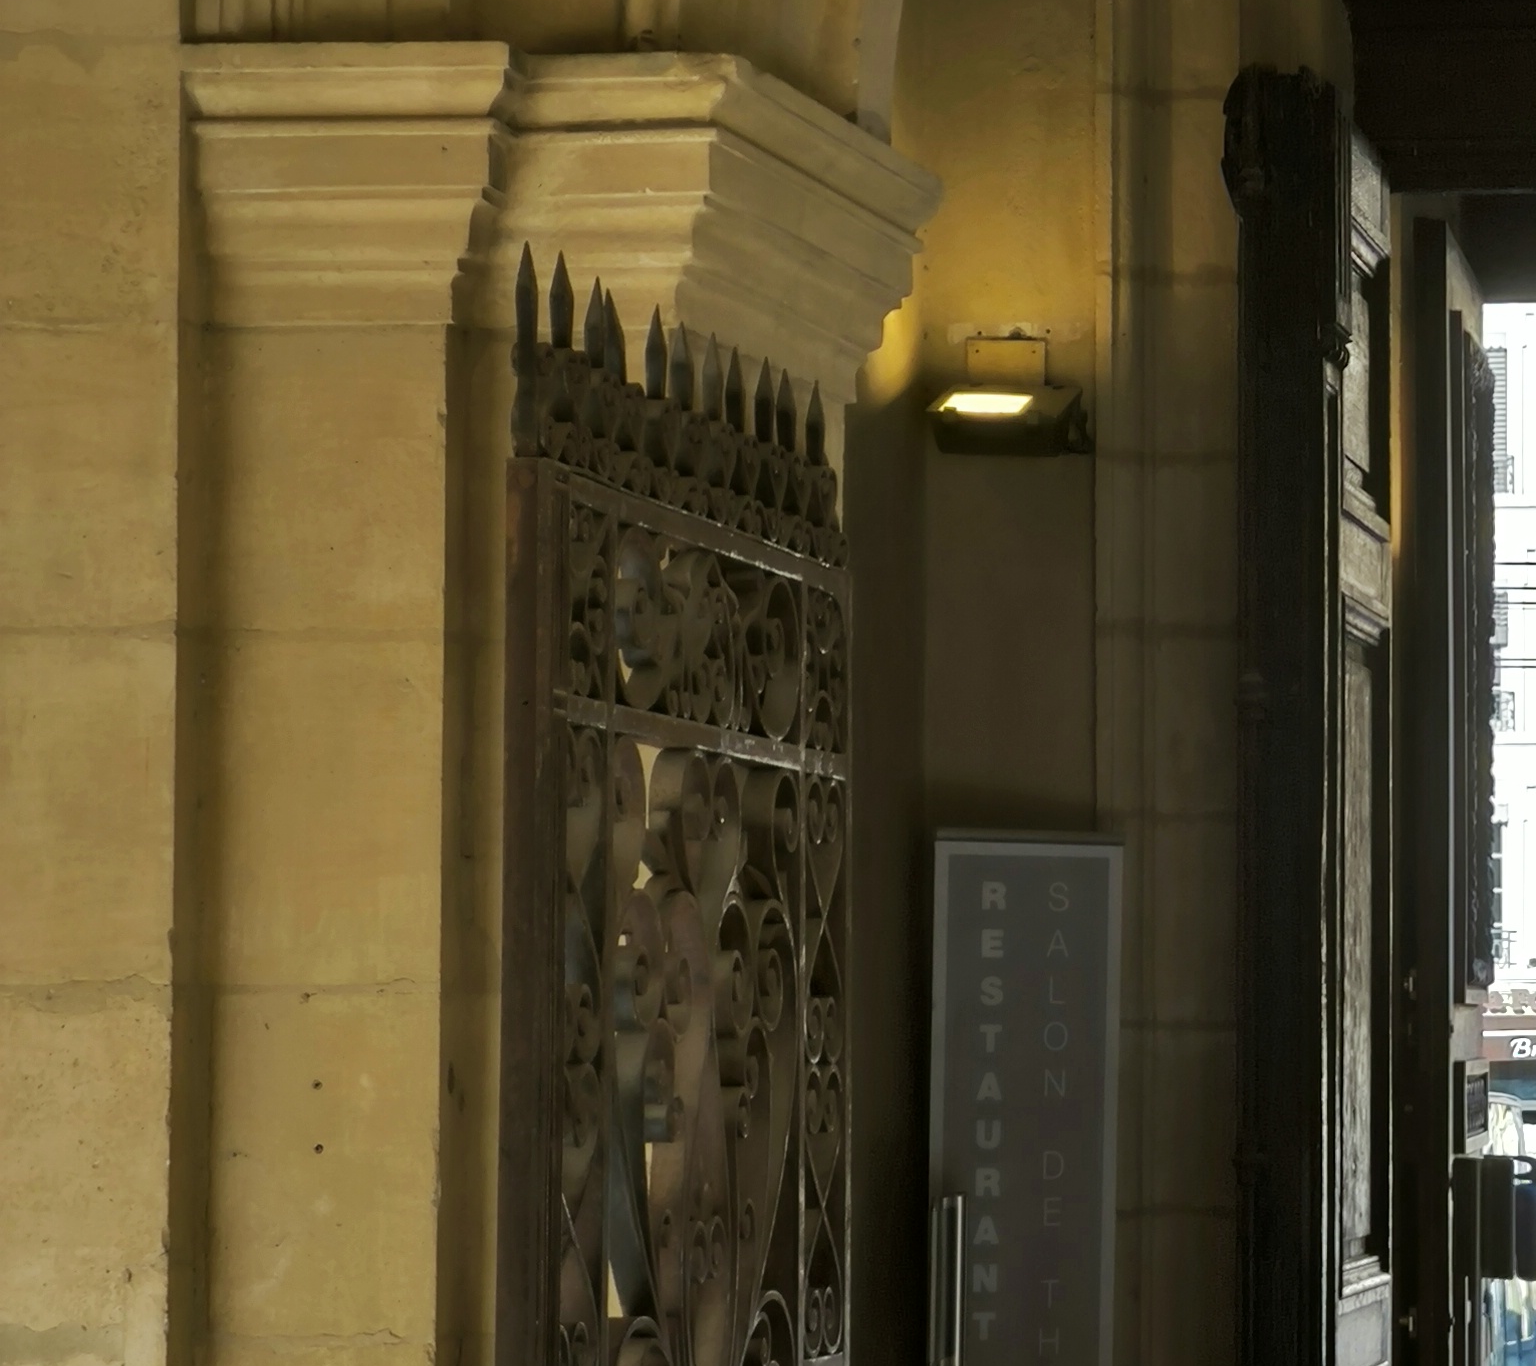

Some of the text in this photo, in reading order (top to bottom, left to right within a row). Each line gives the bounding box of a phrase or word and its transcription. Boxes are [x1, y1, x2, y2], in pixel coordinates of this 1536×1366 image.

[1044, 882, 1069, 1097] SALON
[972, 881, 1006, 1341] RESTAURANT
[1042, 1151, 1064, 1226] DE
